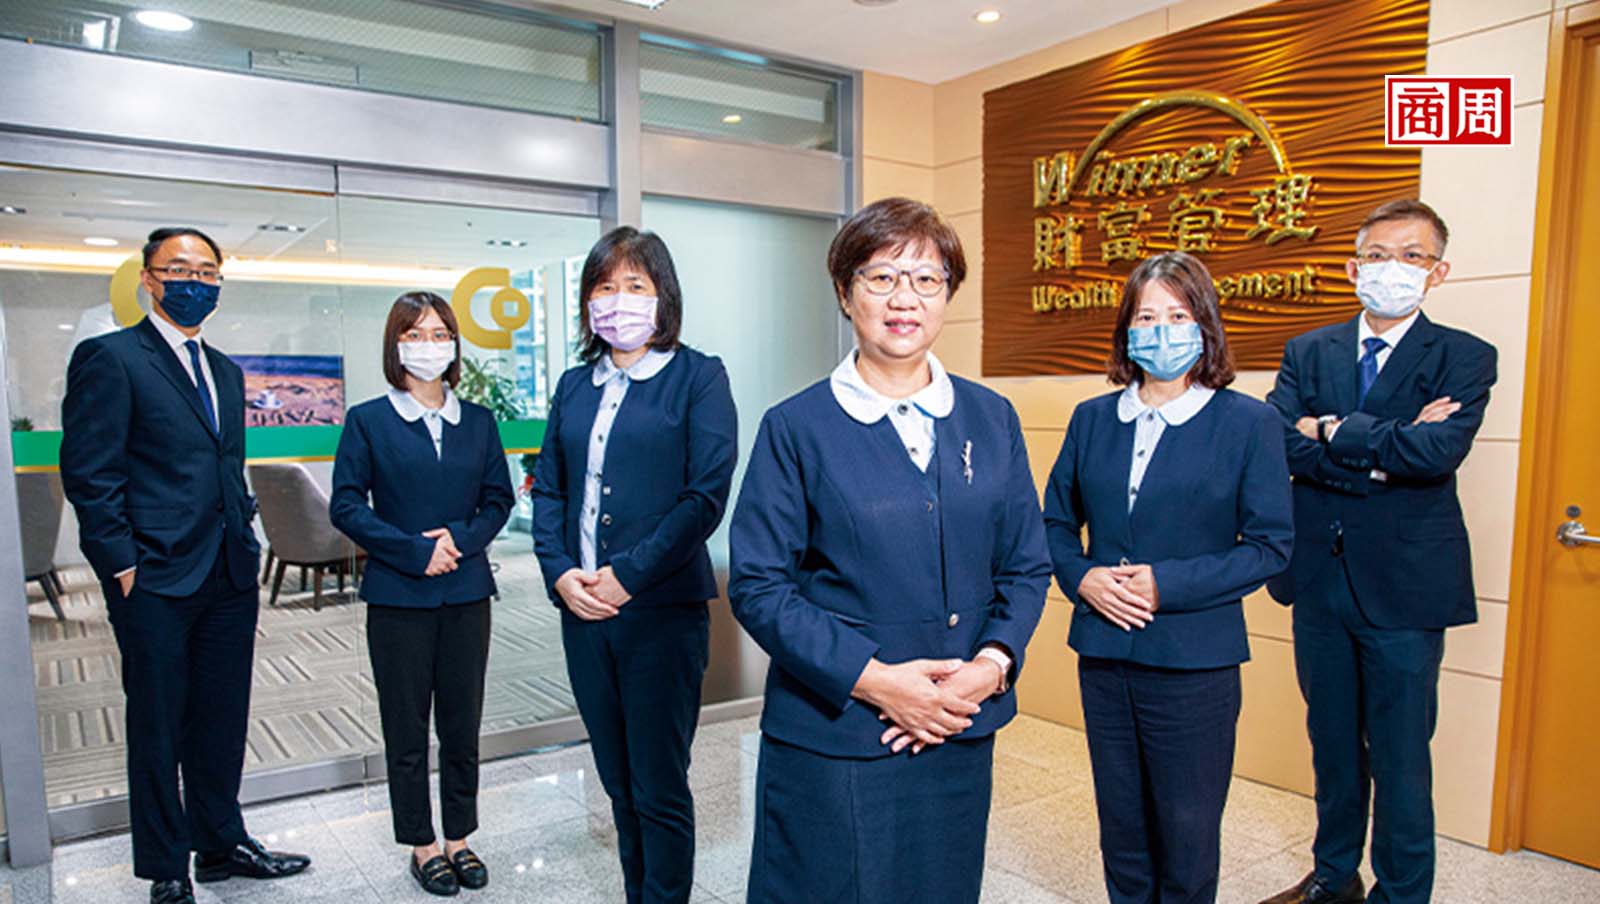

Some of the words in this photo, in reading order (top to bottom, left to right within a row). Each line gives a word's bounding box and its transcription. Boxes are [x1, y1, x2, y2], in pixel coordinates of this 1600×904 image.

[1033, 136, 1249, 208] Winner
[1033, 174, 1319, 271] 財富管理
[1031, 281, 1117, 312] Wealth
